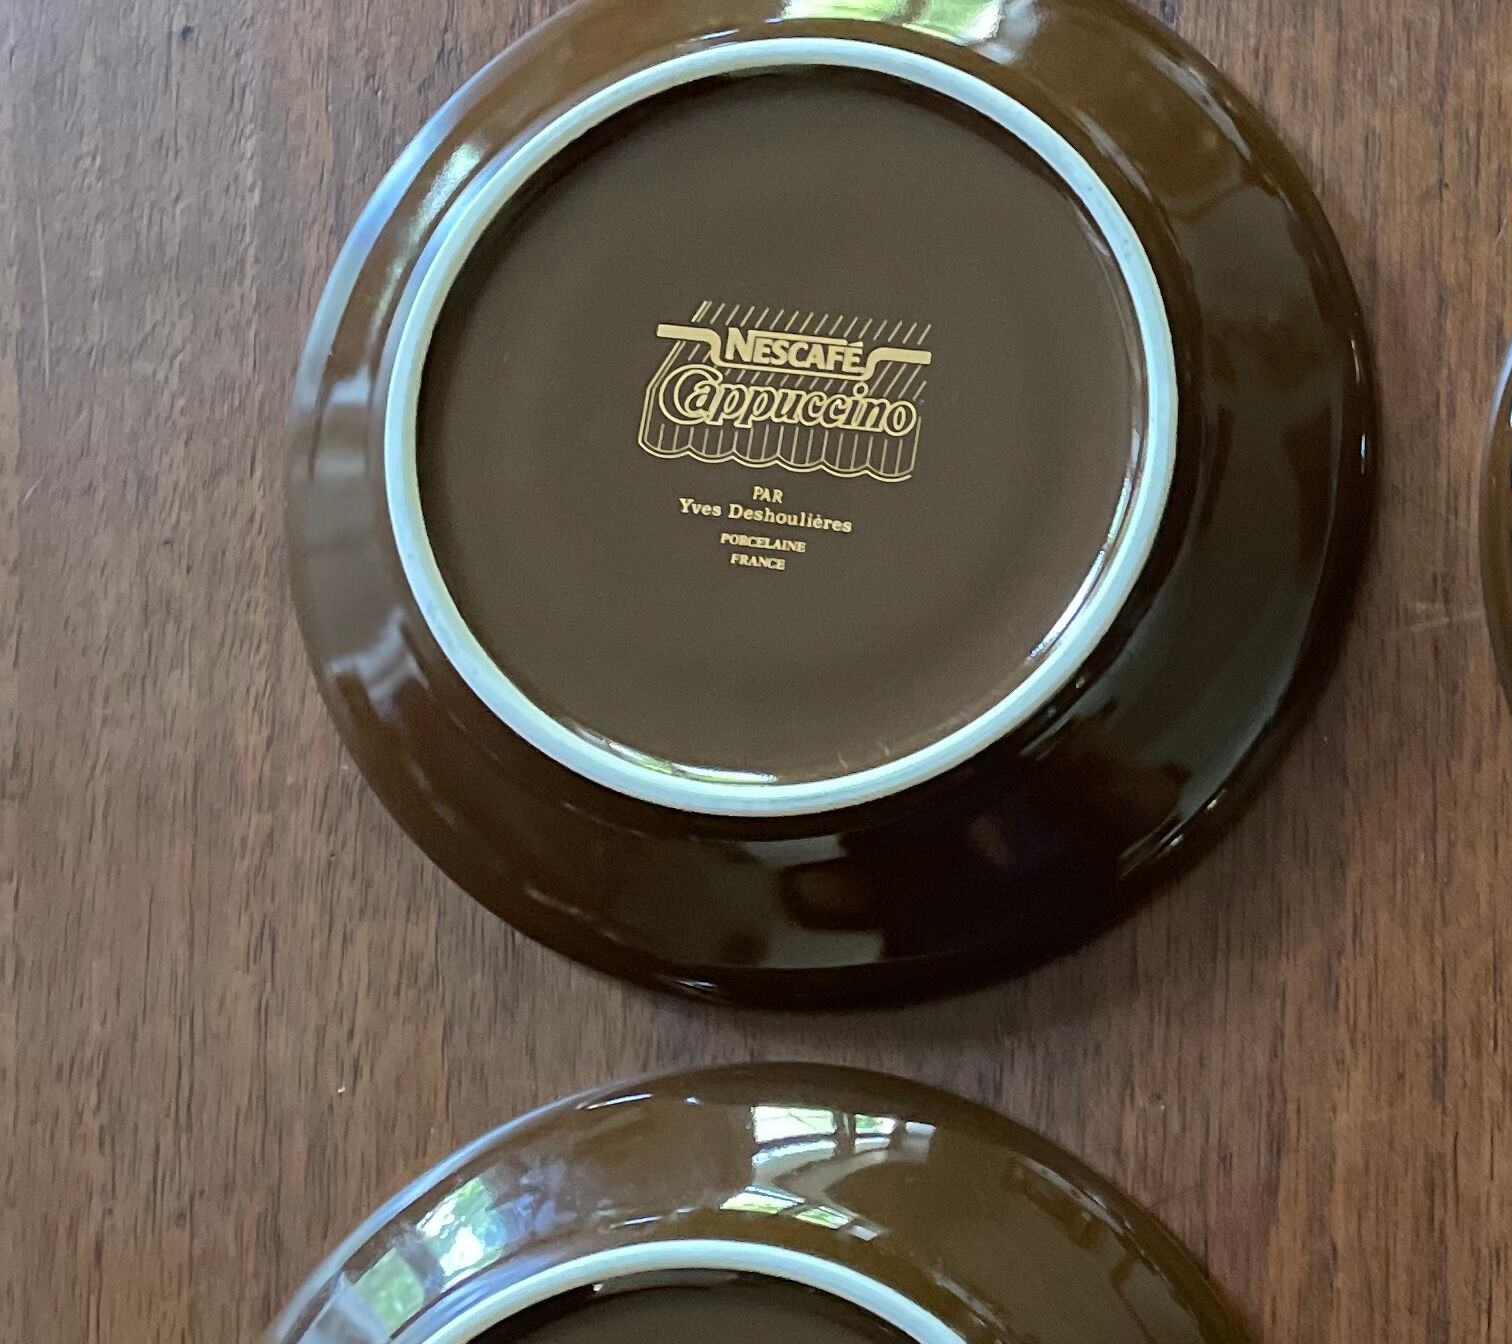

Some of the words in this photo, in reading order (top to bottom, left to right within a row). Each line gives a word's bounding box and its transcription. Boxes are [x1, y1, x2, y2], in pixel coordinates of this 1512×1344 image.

[726, 327, 864, 373] NESCAFÉ
[659, 364, 917, 437] Cappuccino
[752, 486, 783, 504] PAR
[679, 497, 722, 517] Yves
[728, 504, 852, 533] Deshoulières
[720, 532, 806, 553] PORCELAINE
[730, 553, 785, 571] FRANCE
